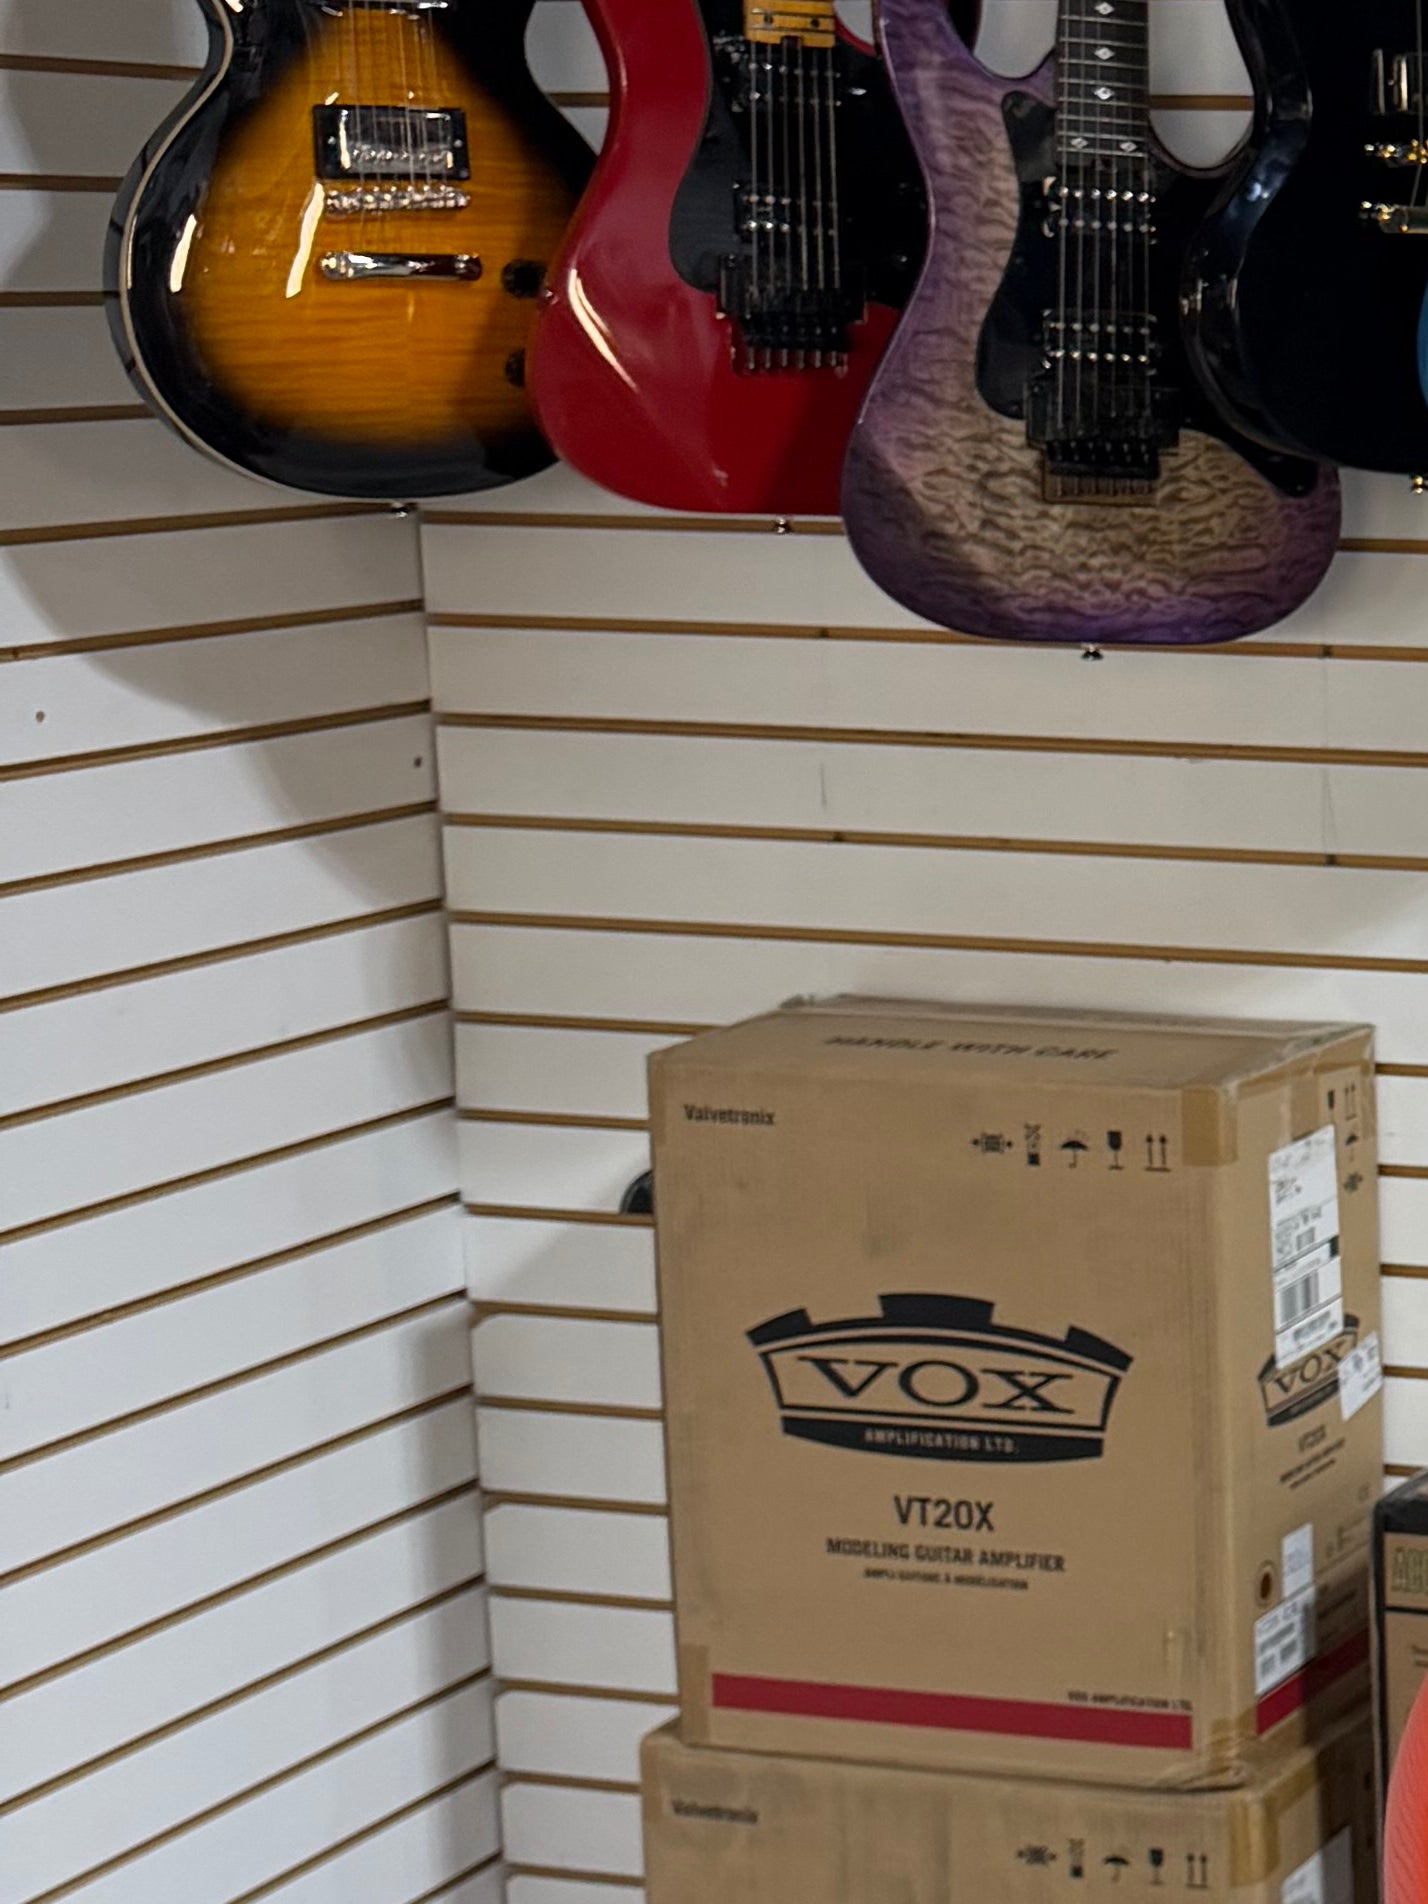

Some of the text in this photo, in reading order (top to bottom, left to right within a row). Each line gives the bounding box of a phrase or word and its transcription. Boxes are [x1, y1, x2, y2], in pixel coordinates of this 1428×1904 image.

[823, 1035, 1118, 1062] HANDLE WITH CARE
[683, 1103, 776, 1127] Valvetronix
[797, 1354, 1076, 1416] VOX
[864, 1427, 1019, 1455] AMPLIFICATION LTD.
[892, 1494, 996, 1533] VT20X
[825, 1536, 1067, 1574] MODELING GUITAR AMPLIFIER
